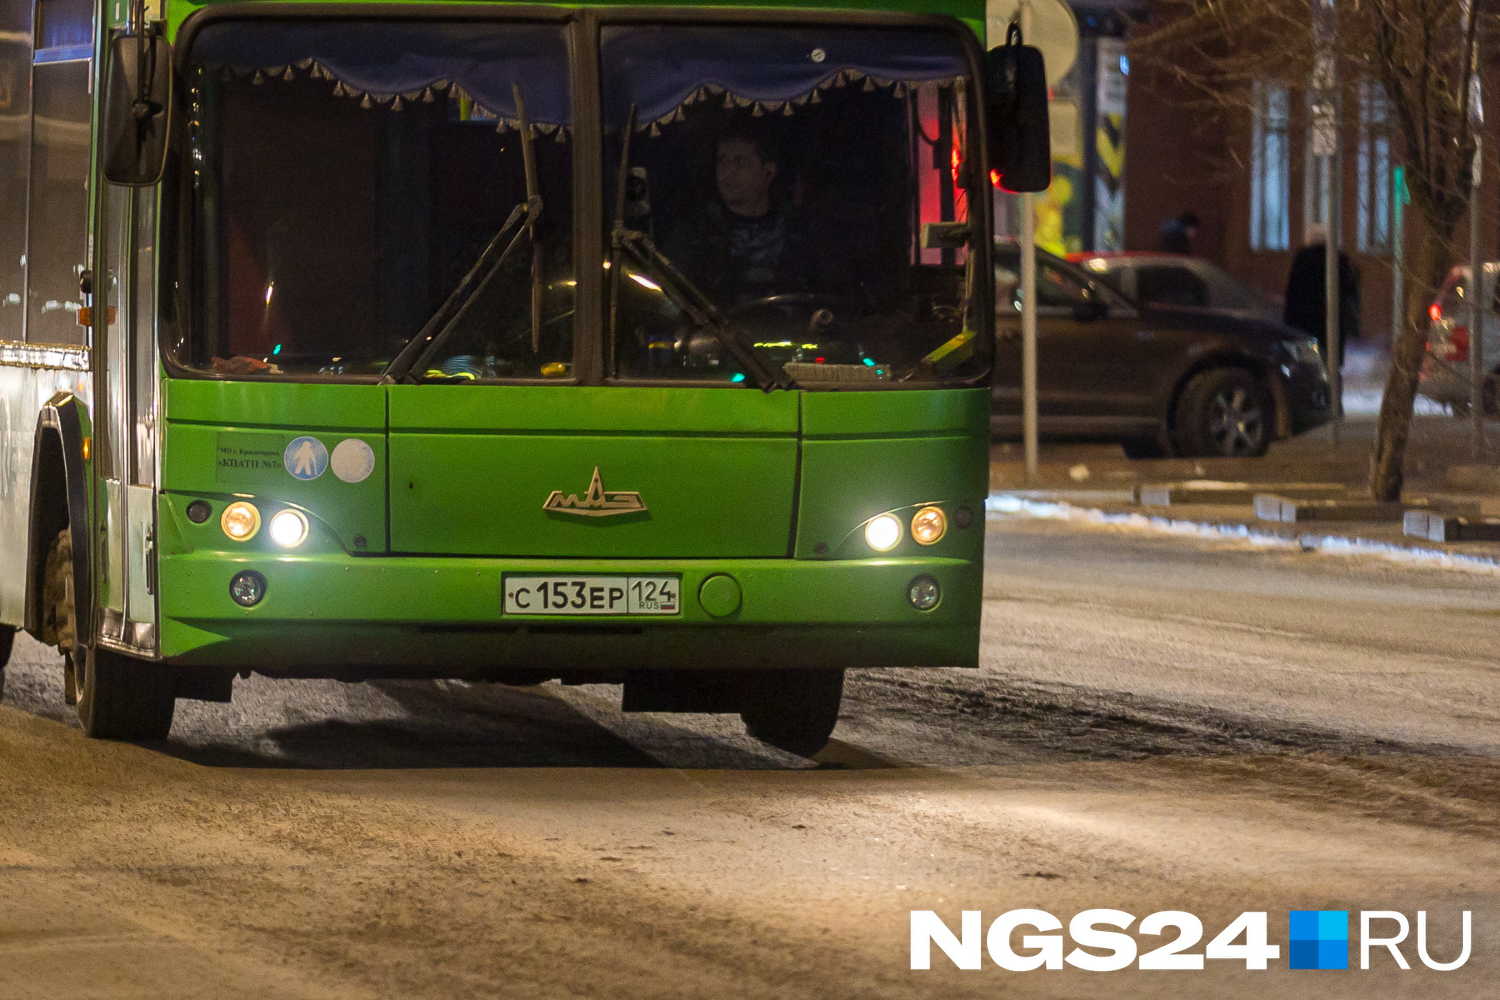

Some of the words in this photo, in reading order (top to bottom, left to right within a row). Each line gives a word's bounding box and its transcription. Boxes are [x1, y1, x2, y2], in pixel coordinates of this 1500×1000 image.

[515, 581, 623, 609] С153ЕР
[631, 581, 674, 602] 124
[638, 602, 660, 610] RUS
